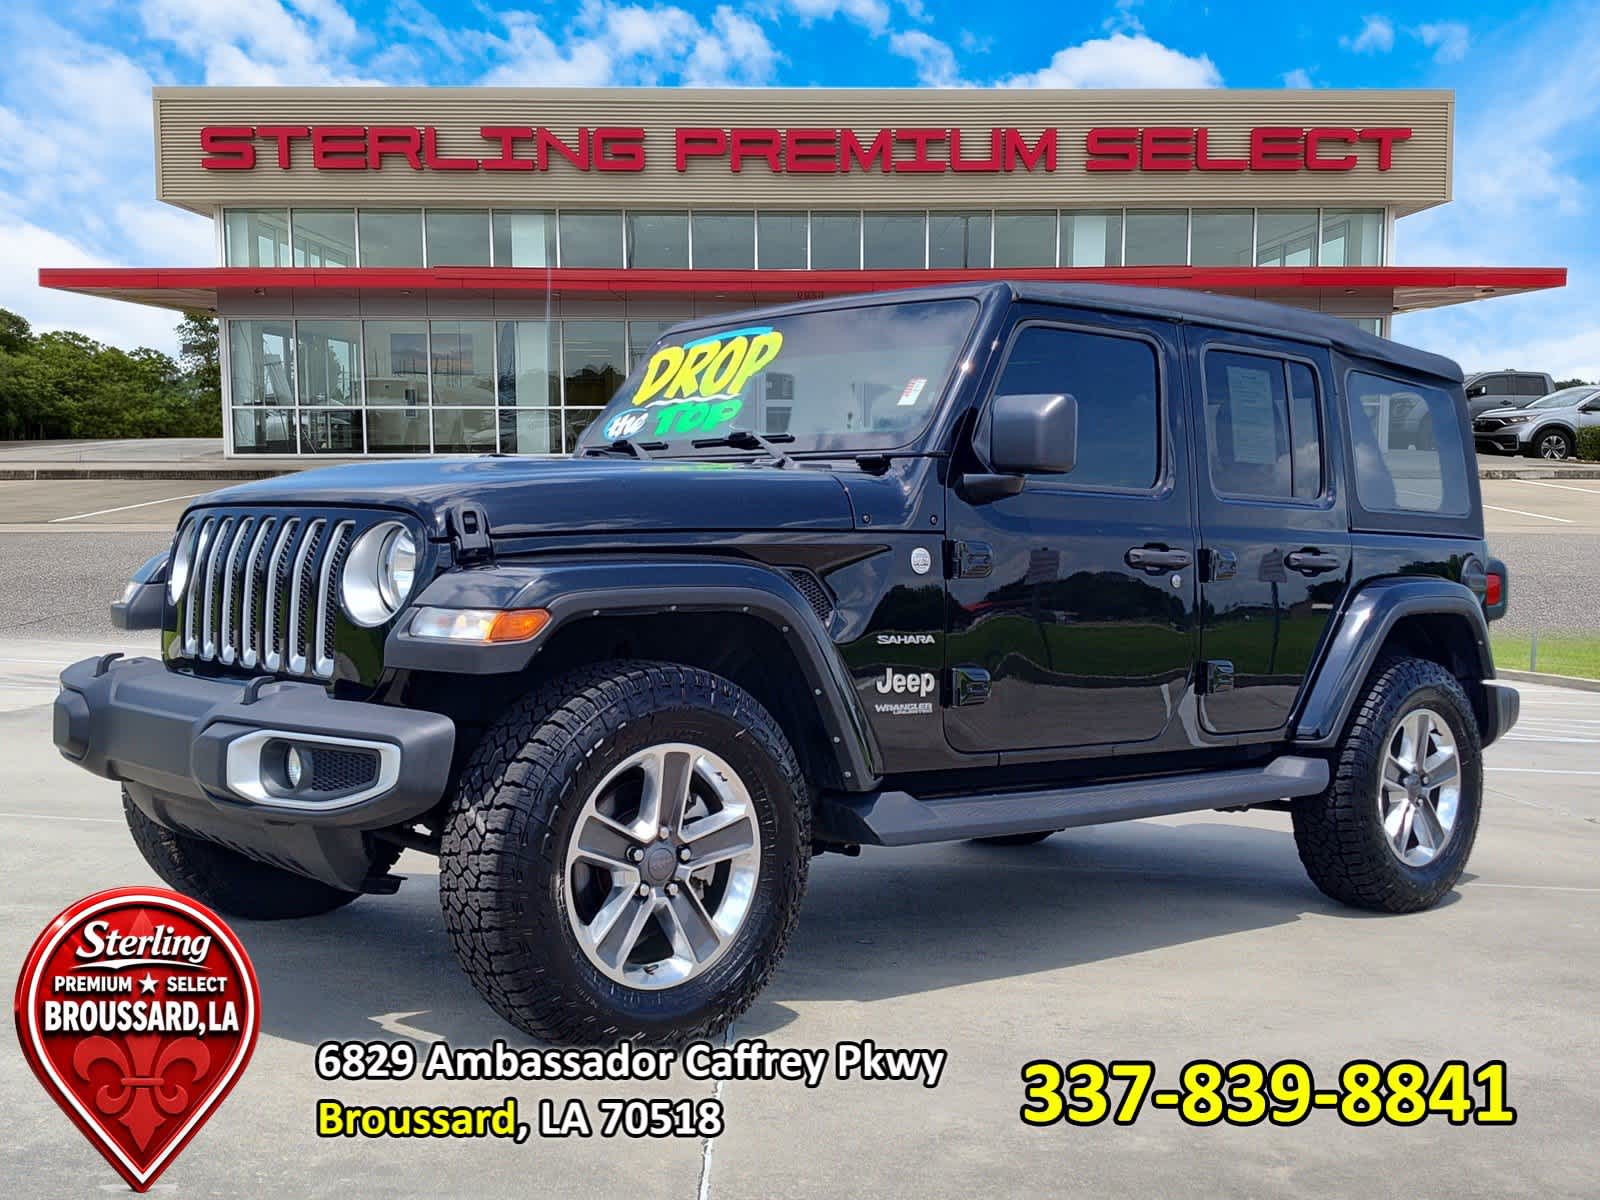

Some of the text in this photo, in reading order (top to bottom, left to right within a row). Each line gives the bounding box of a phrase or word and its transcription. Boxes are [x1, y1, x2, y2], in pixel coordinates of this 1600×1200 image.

[201, 126, 1412, 173] STERLING PREMIUM SELECT
[632, 331, 783, 406] DROP
[655, 399, 743, 437] TOP
[877, 634, 936, 645] SAHARA
[876, 667, 936, 697] Jeep
